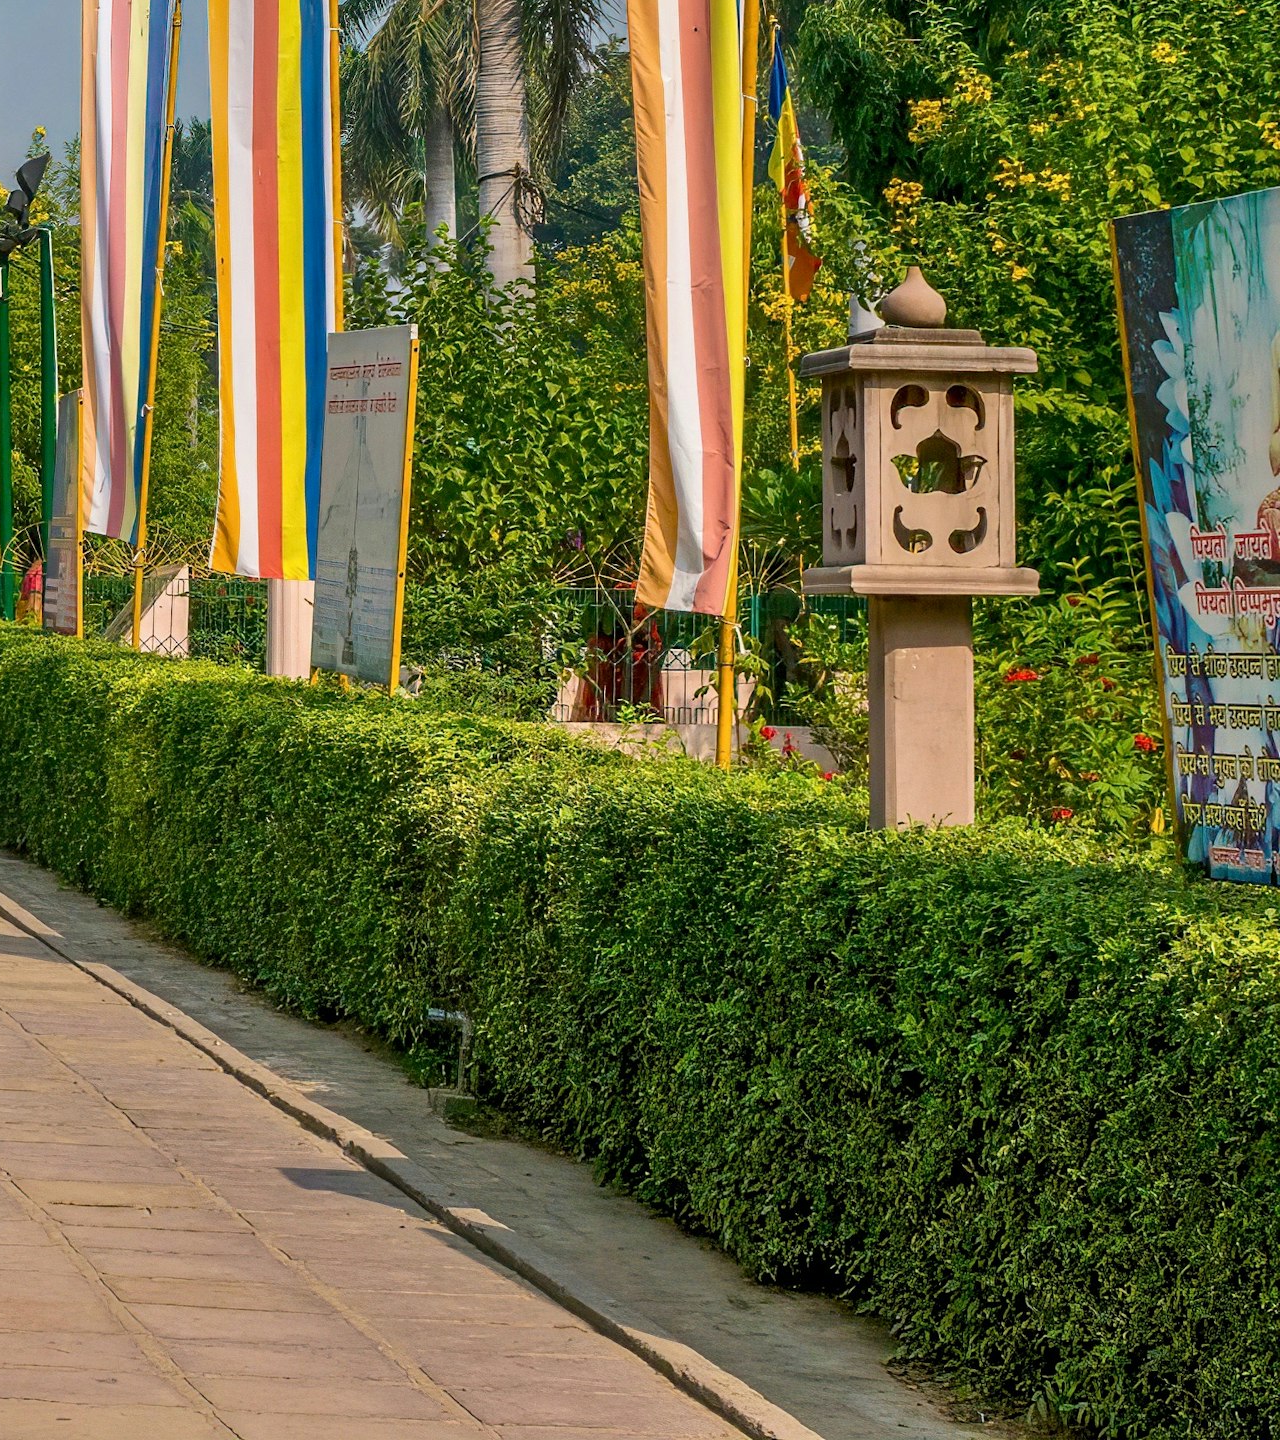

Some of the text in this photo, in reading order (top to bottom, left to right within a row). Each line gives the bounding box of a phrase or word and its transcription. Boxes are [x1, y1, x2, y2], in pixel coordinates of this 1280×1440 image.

[1190, 522, 1226, 559] पियतो
[1234, 519, 1272, 560] जायते
[1195, 577, 1233, 615] पियतो
[1166, 643, 1187, 677] प्रिय
[1188, 643, 1200, 676] से
[1171, 692, 1192, 727] प्रिय
[1193, 693, 1205, 726] से
[1177, 742, 1197, 776] प्रिय
[1198, 745, 1209, 776] से
